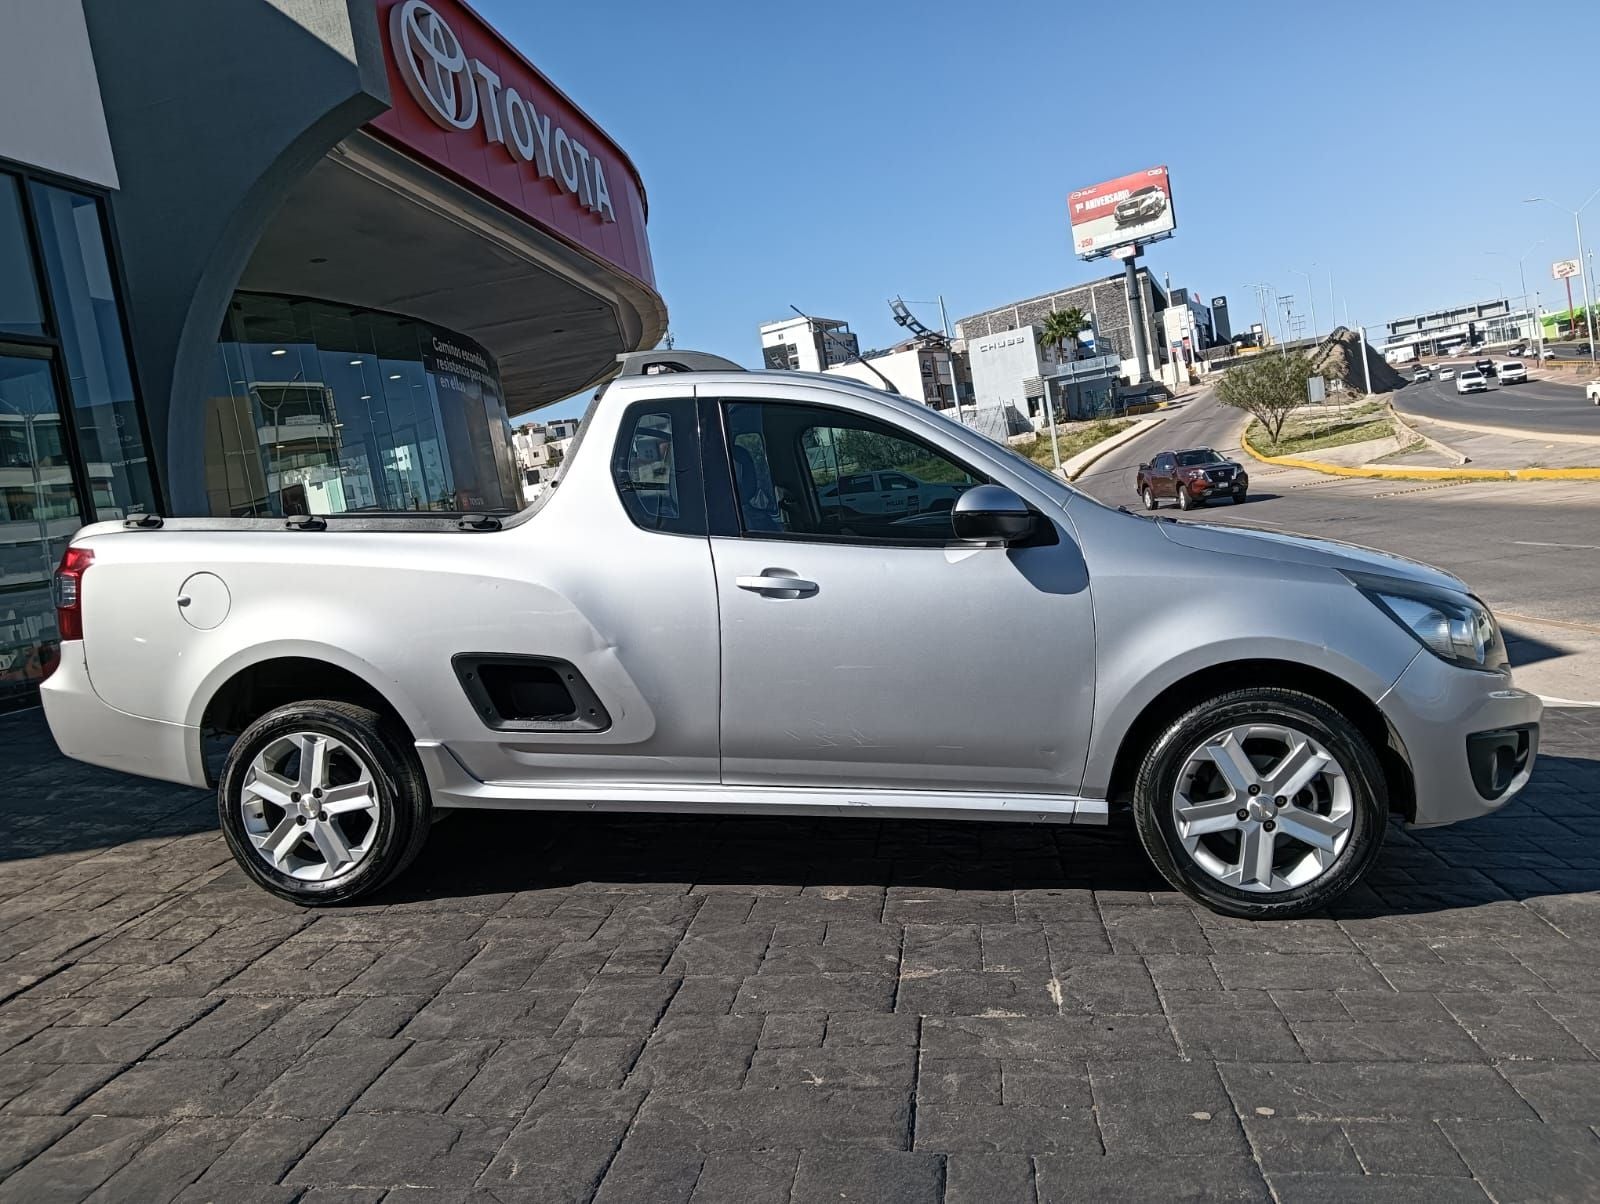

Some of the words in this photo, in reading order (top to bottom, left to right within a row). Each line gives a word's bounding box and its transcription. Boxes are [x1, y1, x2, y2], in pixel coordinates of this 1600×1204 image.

[469, 58, 616, 224] TOYOTA
[432, 337, 461, 358] Caminos
[979, 337, 1025, 353] CHUBB
[440, 377, 450, 388] en
